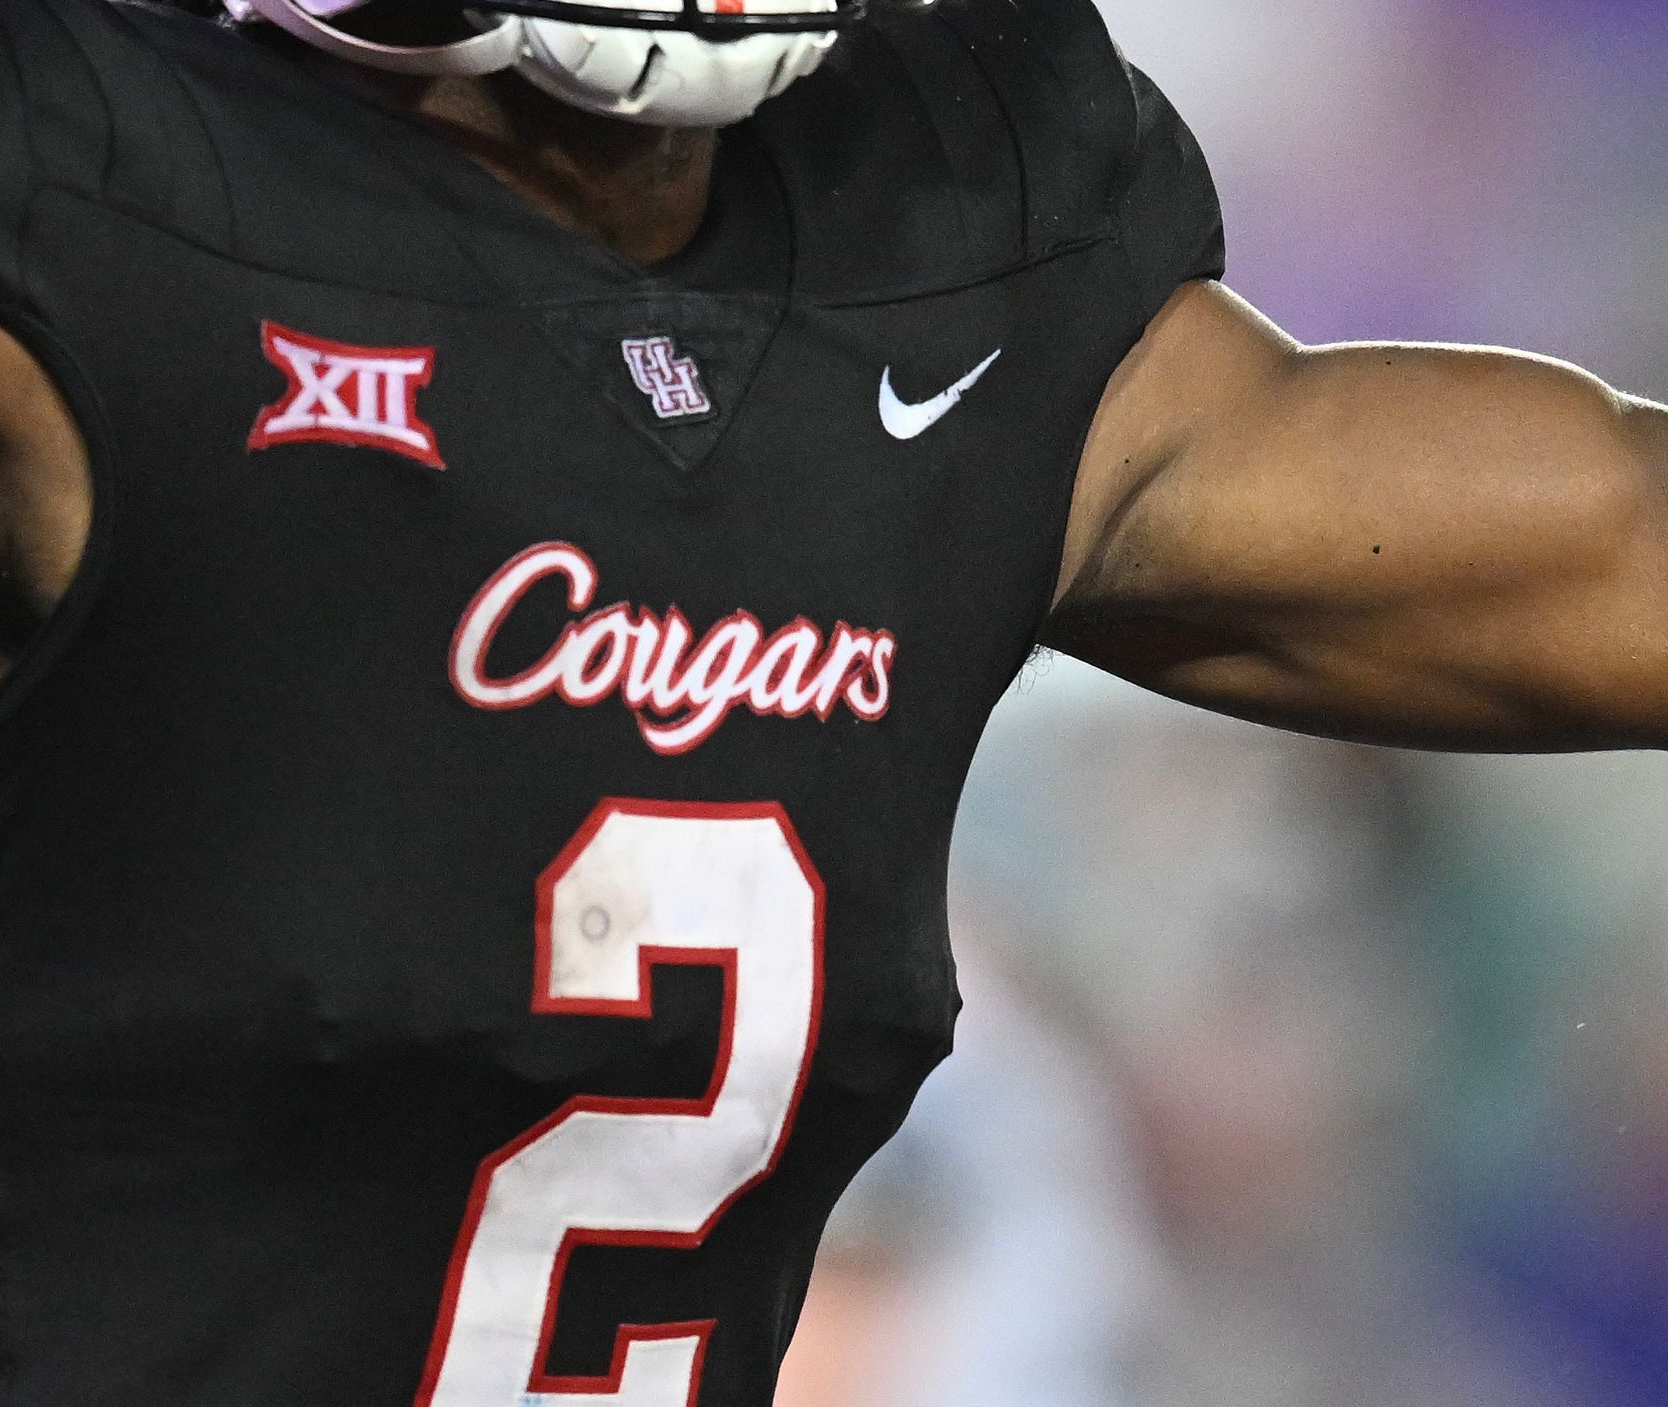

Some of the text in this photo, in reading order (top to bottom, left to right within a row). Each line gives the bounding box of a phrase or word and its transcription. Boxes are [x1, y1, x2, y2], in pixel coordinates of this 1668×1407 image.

[256, 328, 436, 456] XII
[448, 540, 897, 756] Cougars
[414, 796, 826, 1407] 2
